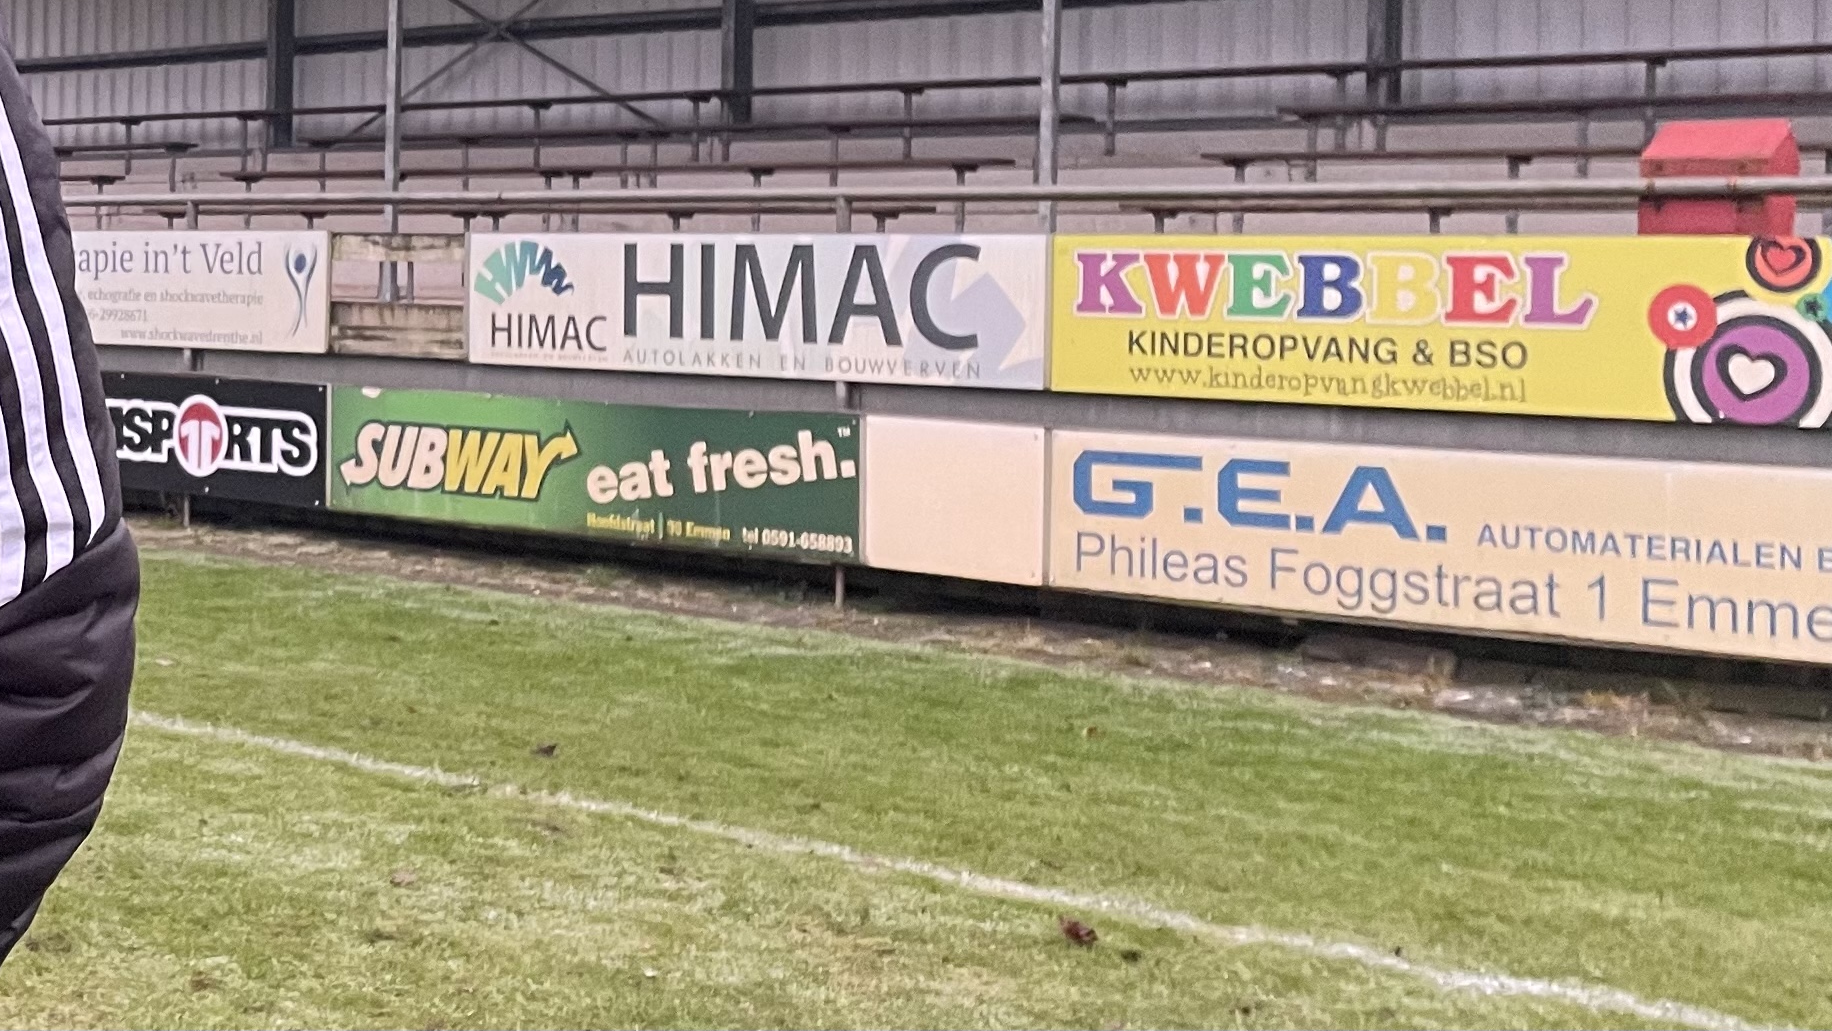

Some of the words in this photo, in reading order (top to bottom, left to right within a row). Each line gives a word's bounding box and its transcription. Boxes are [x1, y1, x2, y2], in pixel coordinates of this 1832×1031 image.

[78, 241, 134, 280] apie
[200, 242, 263, 275] Veld
[624, 243, 981, 350] HIMAC
[1074, 251, 1596, 329] KWEBBEL
[491, 312, 607, 351] HIMAC
[623, 349, 761, 369] AUTOLAKKEN
[779, 354, 805, 371] EN
[824, 355, 981, 379] BOUWVERVEN
[1128, 330, 1398, 365] KINDEROPVANG
[1412, 339, 1434, 365] &
[1449, 340, 1529, 369] BSO
[340, 423, 578, 500] SUBWAY
[587, 449, 674, 504] eat
[687, 430, 856, 493] fresh.
[1073, 449, 1447, 543] G.E.A.
[1477, 523, 1802, 570] AUTOMATERIALEN
[1075, 530, 1248, 588] Phileas
[1270, 547, 1561, 618] Foggstraat
[1587, 571, 1606, 622] 1
